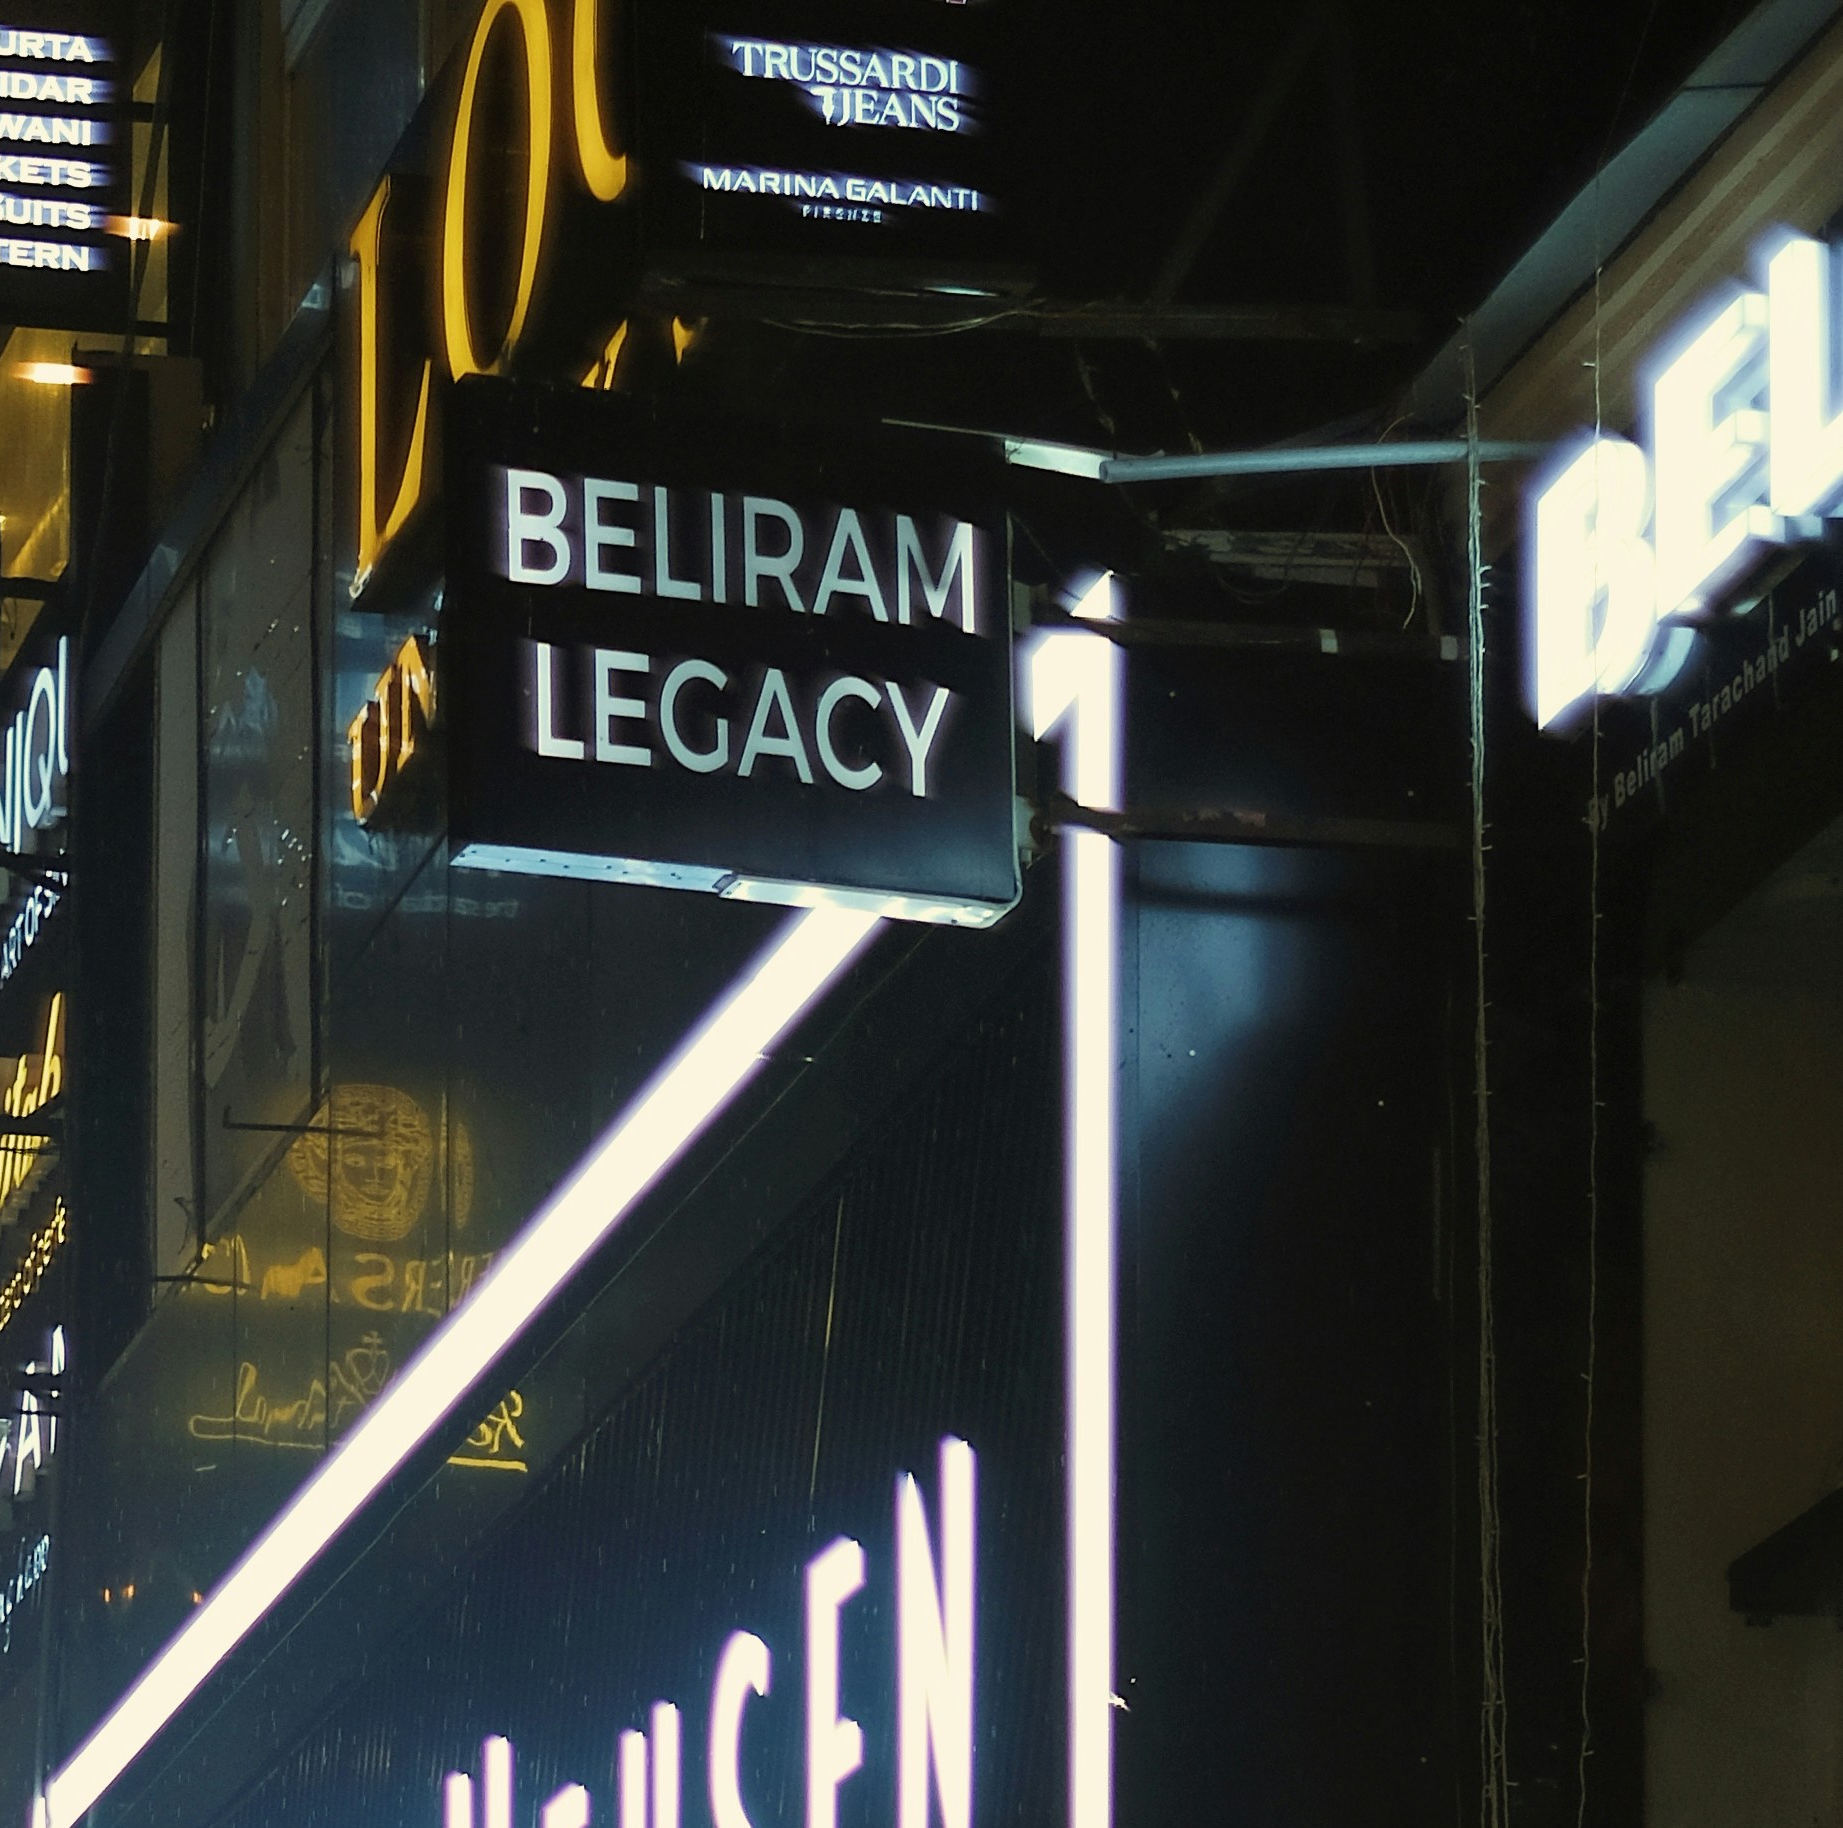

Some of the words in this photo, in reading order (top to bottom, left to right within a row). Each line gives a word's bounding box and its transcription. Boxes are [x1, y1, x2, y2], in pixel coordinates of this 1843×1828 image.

[732, 41, 958, 94] TRUSSARDI
[838, 87, 960, 131] JEANS
[703, 167, 839, 199] MARINA
[845, 179, 978, 211] GALANTI
[507, 468, 975, 634] BELIRAM
[537, 641, 950, 798] LEGACY
[1613, 729, 1685, 810] Beliram
[1689, 630, 1792, 732] Tarachand
[1796, 586, 1839, 649] Jain
